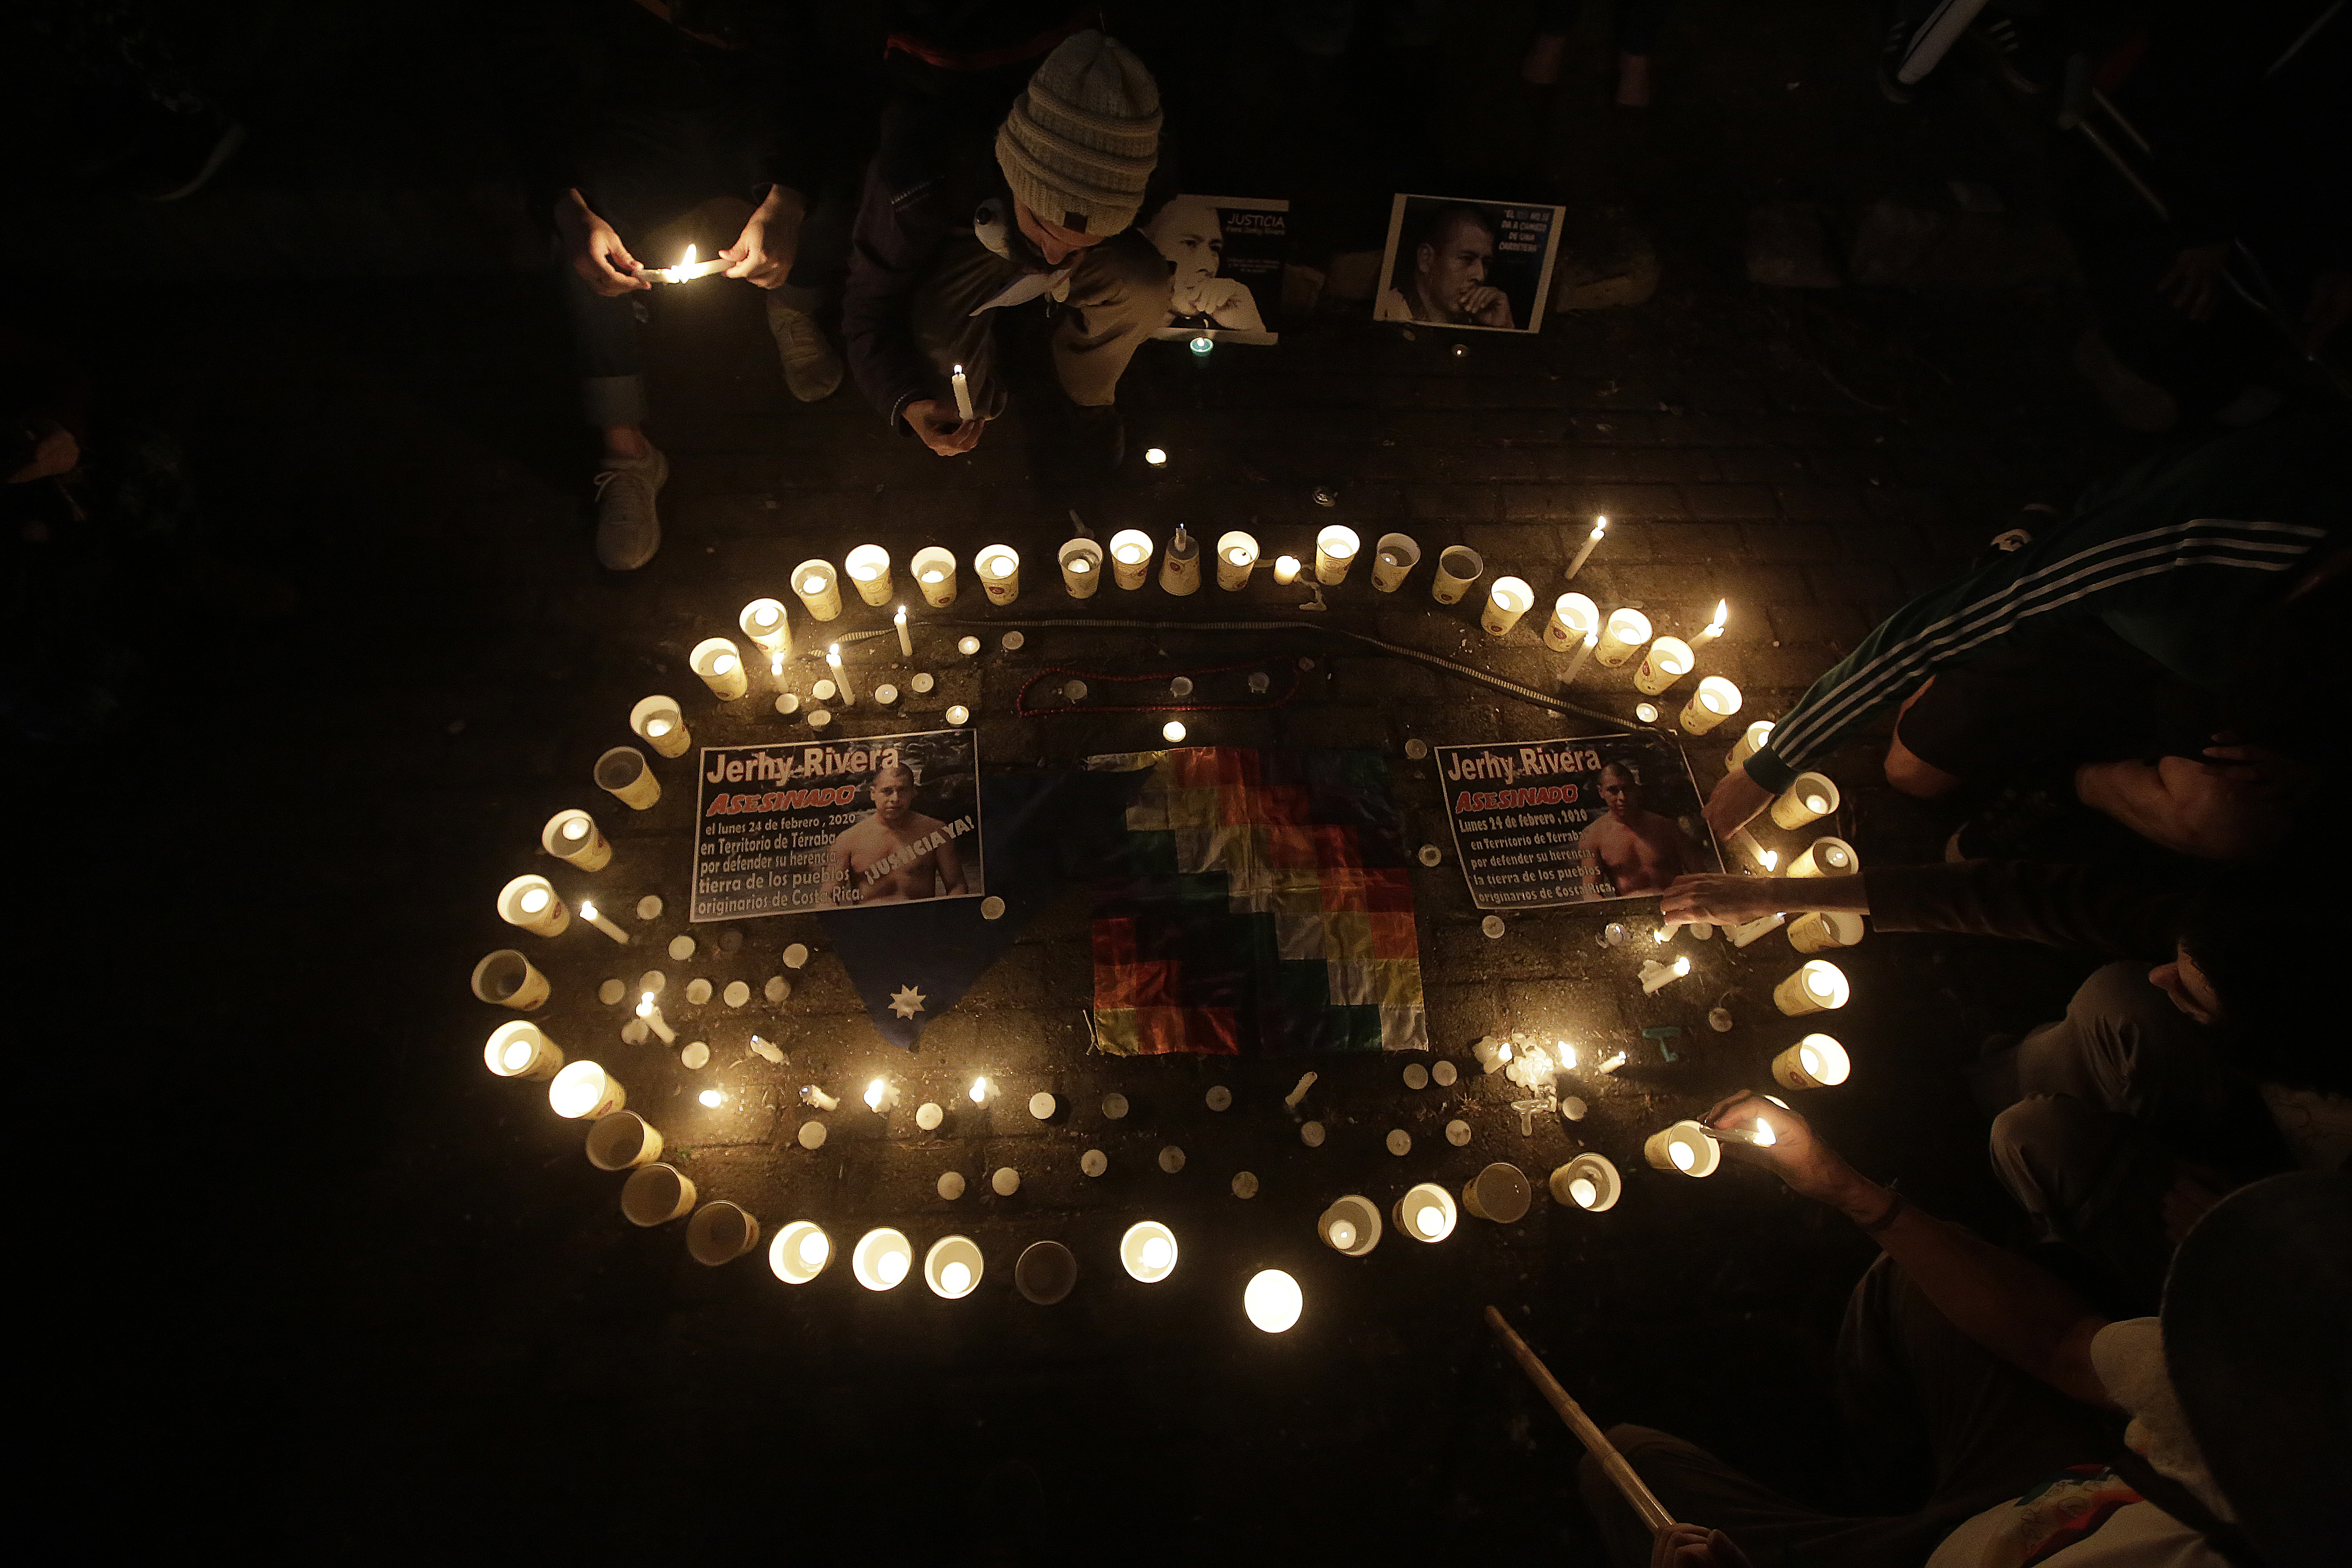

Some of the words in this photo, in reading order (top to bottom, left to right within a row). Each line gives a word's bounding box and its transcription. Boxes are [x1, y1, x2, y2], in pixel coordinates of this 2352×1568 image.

[1227, 213, 1285, 228] JUSTICIA
[706, 751, 794, 787] Jerhy
[804, 746, 899, 776] Rivera
[1448, 750, 1514, 785] Jerhy
[1519, 746, 1603, 776] Rivera
[706, 785, 855, 817] ASESINADO
[1455, 784, 1579, 815] ASESINADO
[706, 822, 715, 835] el
[718, 822, 746, 834] lunes
[748, 821, 762, 832] 24
[764, 818, 778, 831] de
[829, 813, 856, 826] 2020
[940, 815, 975, 839] YA!
[1459, 819, 1488, 833] Lunes
[1489, 816, 1503, 831] 24
[1505, 815, 1518, 829] de
[700, 842, 715, 856] en
[718, 835, 771, 855] Territorio
[774, 833, 788, 849] de
[791, 829, 836, 848] Térraba
[1471, 841, 1483, 851] en
[1483, 834, 1532, 849] Territorio
[1534, 833, 1546, 845] de
[700, 861, 721, 878] por
[723, 853, 772, 873] defender
[775, 855, 786, 868] su
[1470, 858, 1488, 871] por
[1490, 853, 1534, 867] defender
[1536, 852, 1548, 863] su
[699, 877, 741, 894] tierra
[746, 872, 764, 890] de
[768, 871, 787, 887] los
[792, 866, 849, 889] pueblos
[1473, 874, 1485, 885] la
[1487, 873, 1520, 885] tierra
[1522, 871, 1536, 882] de
[1538, 869, 1555, 881] los
[1557, 865, 1601, 881] pueblos
[698, 893, 768, 915] originarios
[771, 890, 788, 907] de
[791, 889, 829, 906] Costa
[832, 885, 864, 902] Rica.
[1478, 890, 1537, 904] originarios
[1539, 887, 1553, 899] de
